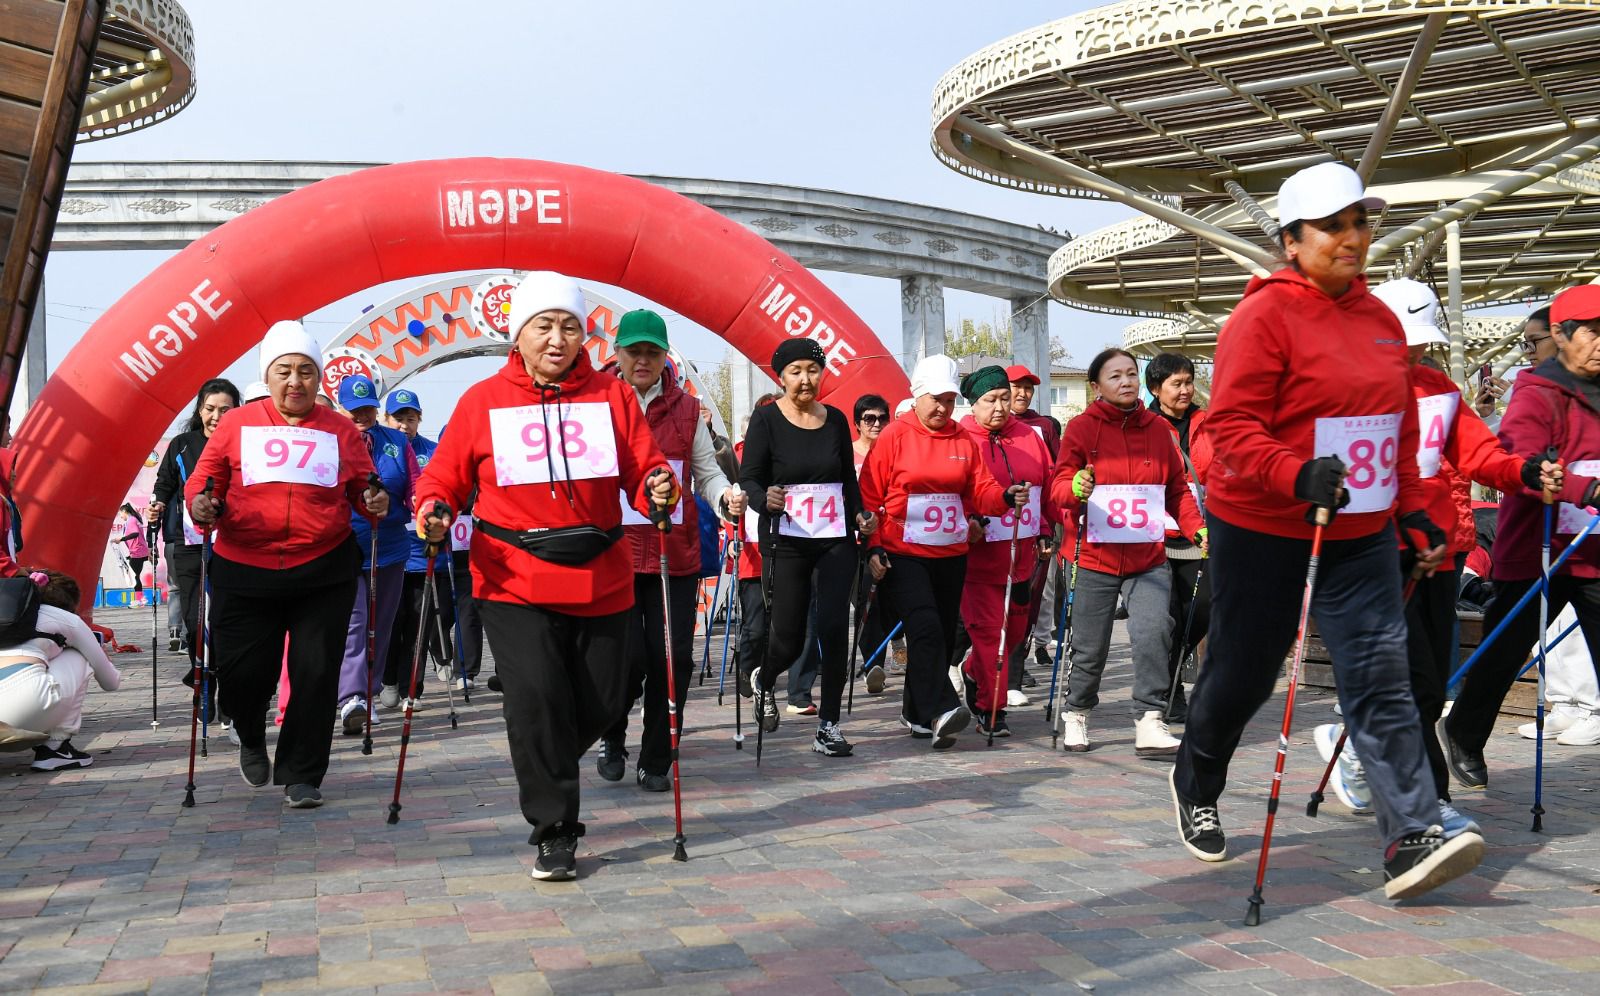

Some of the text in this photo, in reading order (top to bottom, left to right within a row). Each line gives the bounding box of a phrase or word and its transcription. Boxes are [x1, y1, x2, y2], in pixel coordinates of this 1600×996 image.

[446, 188, 562, 227] МӘРЕ
[119, 278, 233, 382] МӘРЕ
[760, 282, 857, 377] МӘРЕ
[264, 438, 318, 469] 97
[520, 419, 588, 463] 98
[1346, 436, 1395, 490] 89
[923, 505, 957, 534] 93
[1106, 498, 1149, 529] 85
